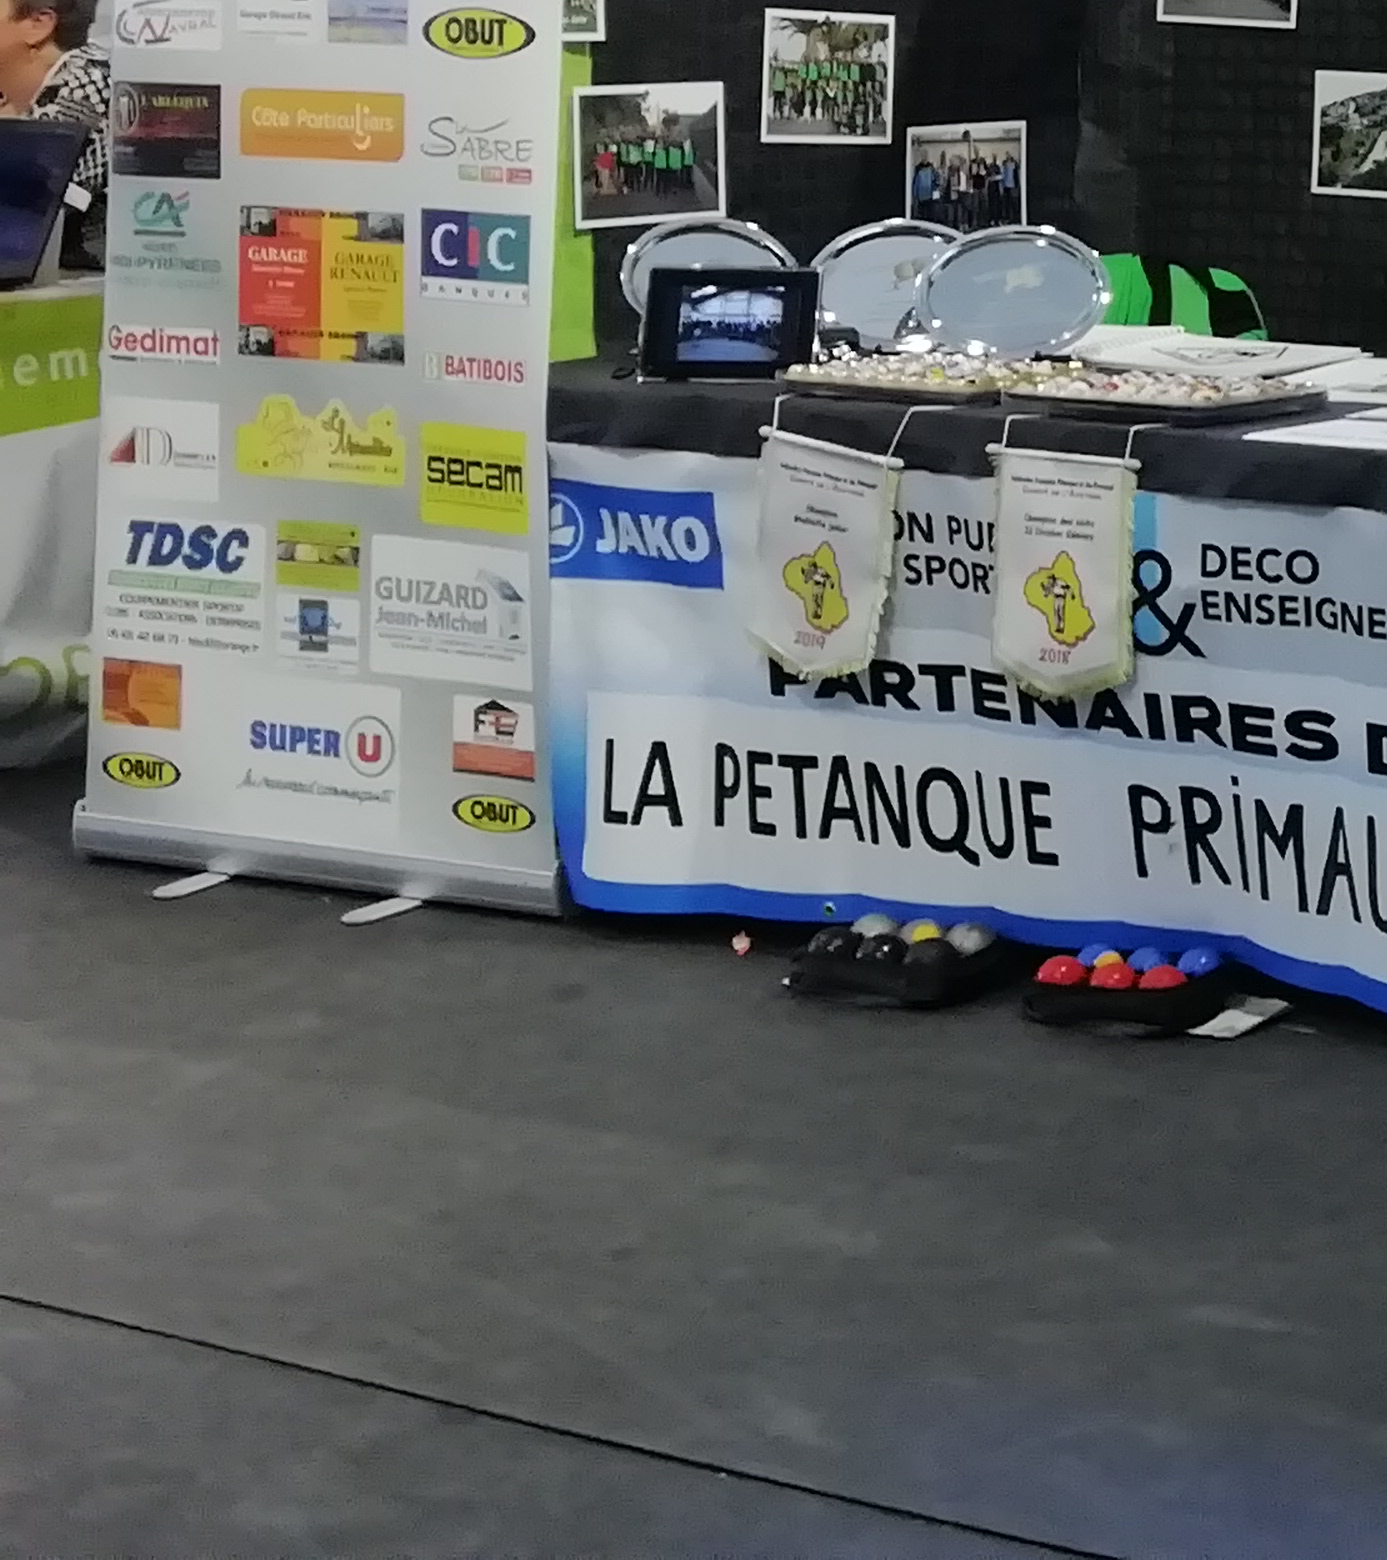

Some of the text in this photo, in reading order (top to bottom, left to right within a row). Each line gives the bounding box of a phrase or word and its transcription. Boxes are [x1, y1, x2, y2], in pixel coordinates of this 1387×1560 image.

[444, 17, 507, 47] OBUT
[248, 246, 309, 264] GARAGE
[334, 251, 395, 268] GARAGE
[431, 222, 518, 272] CIC
[329, 267, 400, 284] RENAULT
[108, 324, 221, 357] Gedimat
[445, 355, 525, 384] BATIBOIS
[427, 455, 523, 494] secam
[126, 519, 250, 574] TDSC
[596, 507, 710, 564] JAKO
[1200, 543, 1320, 585] DECO
[375, 576, 488, 611] GUIZARD
[376, 606, 487, 635] Jean-Michel
[769, 657, 1339, 762] PARTENAIRES
[250, 720, 381, 763] SUPER U
[119, 758, 166, 782] OBUT
[470, 800, 521, 825] OBUT
[603, 739, 683, 827] LA
[714, 742, 1060, 868] PETANQUE
